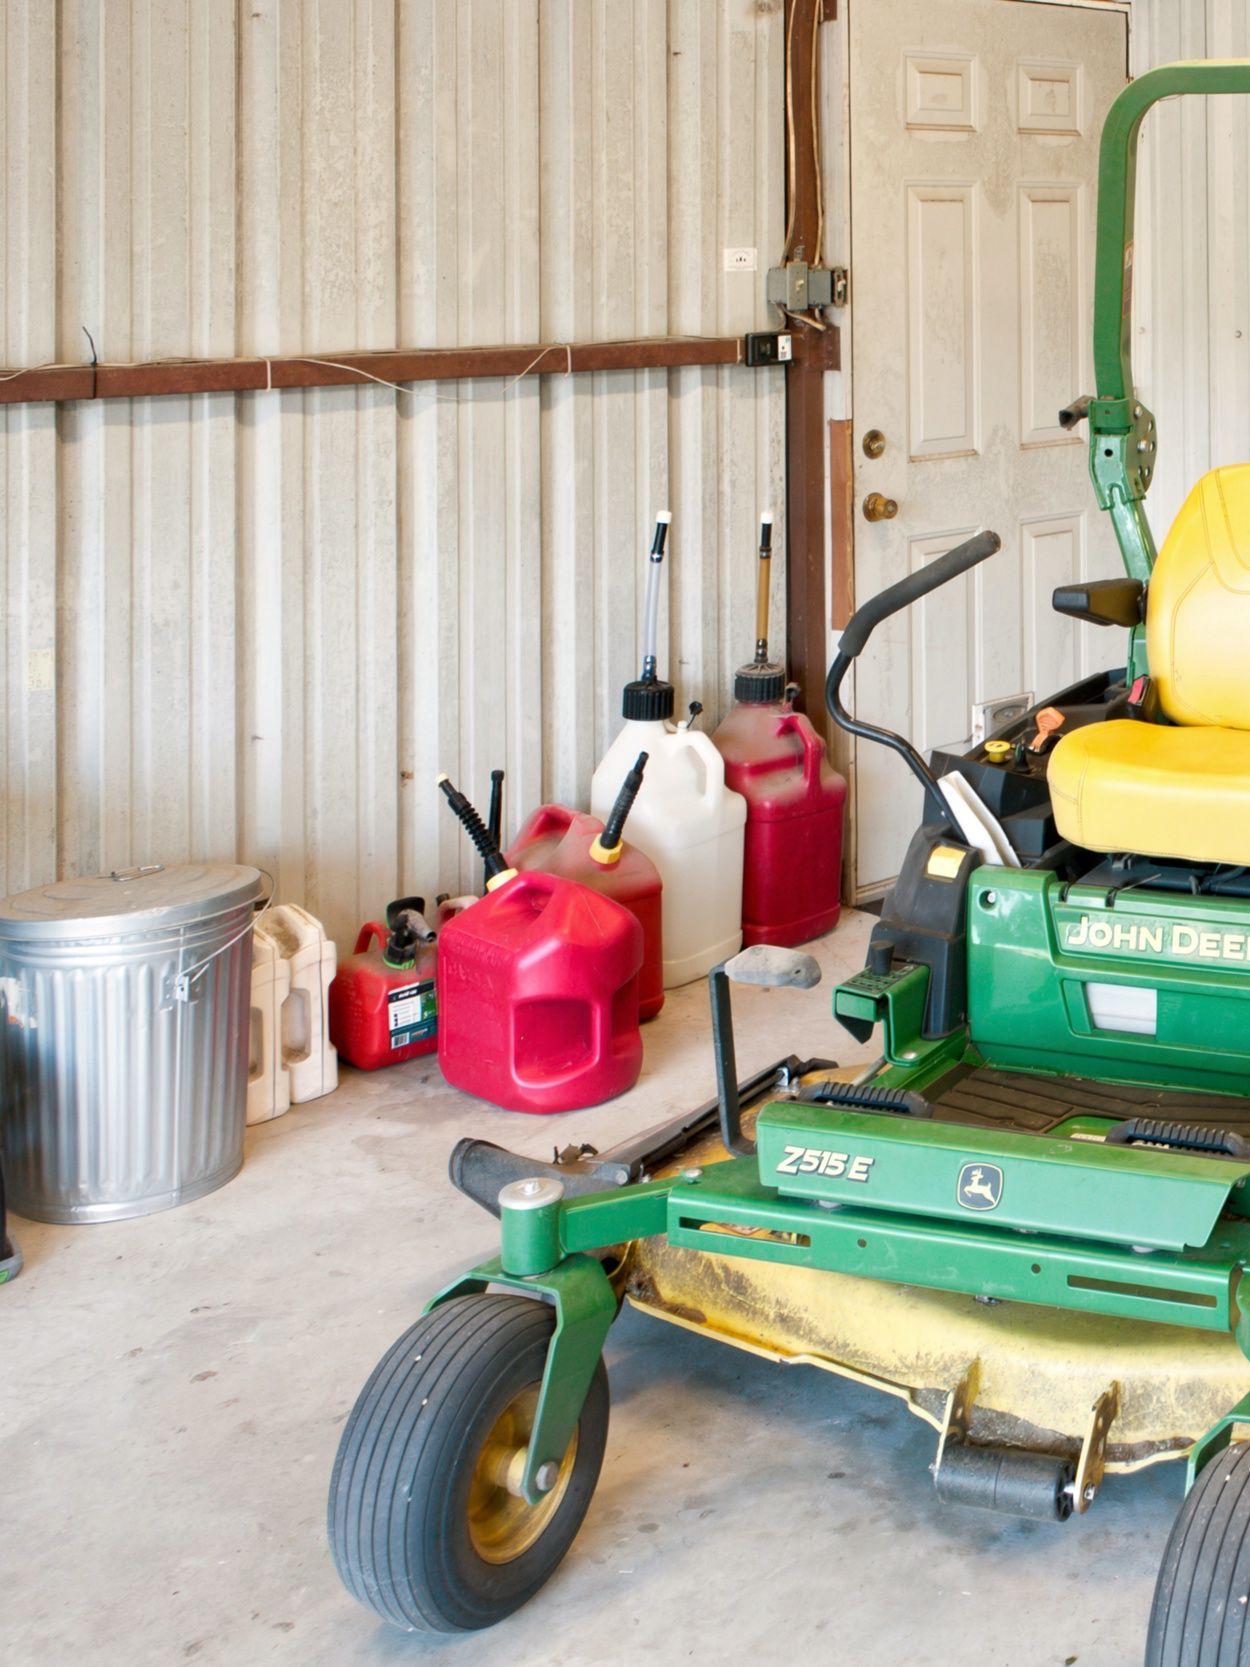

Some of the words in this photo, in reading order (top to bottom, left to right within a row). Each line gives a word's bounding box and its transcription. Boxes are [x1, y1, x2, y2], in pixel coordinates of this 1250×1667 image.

[1067, 916, 1163, 953] JOHN
[776, 1145, 849, 1178] Z515
[847, 1155, 875, 1183] E
